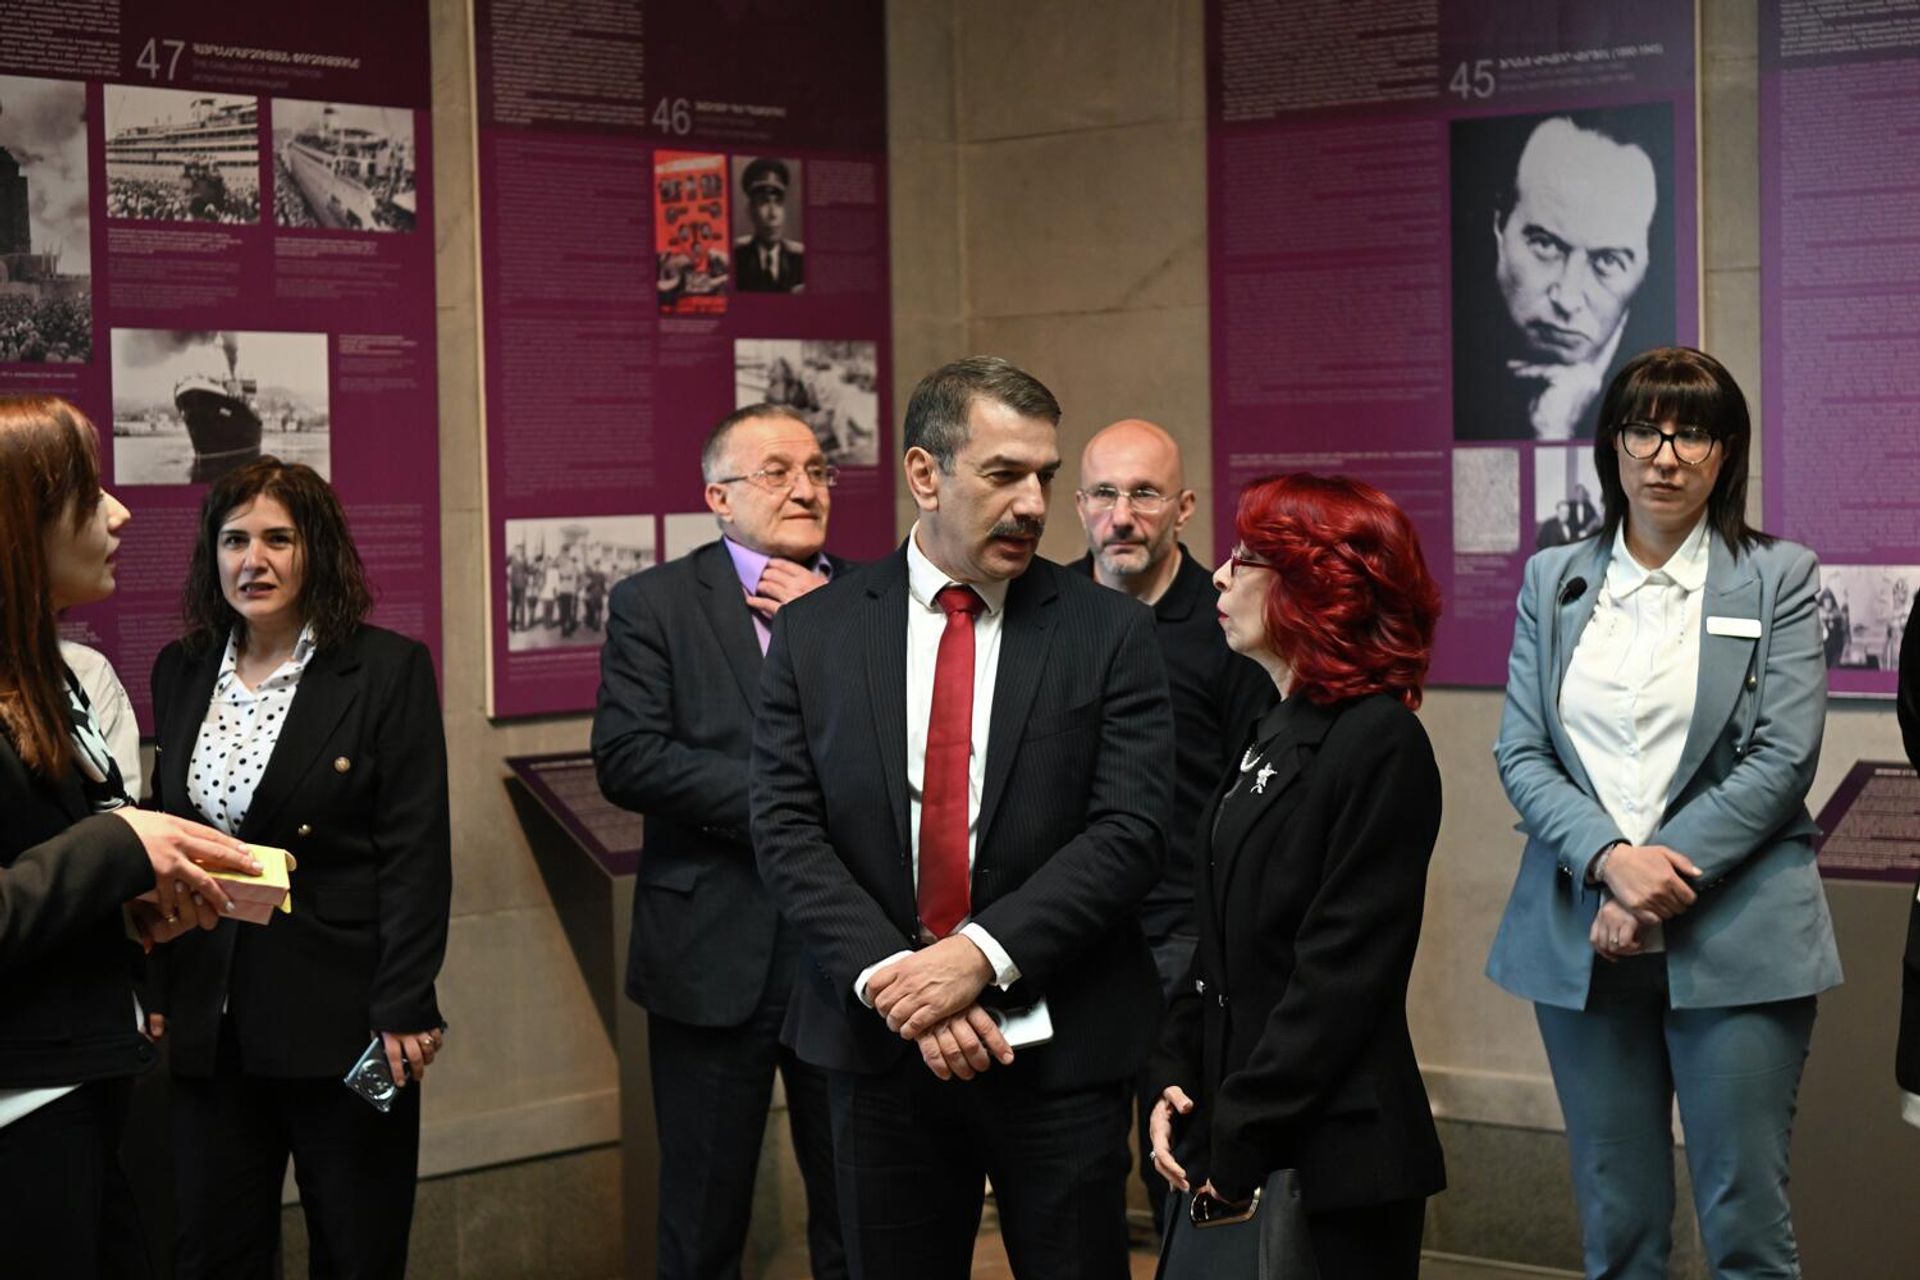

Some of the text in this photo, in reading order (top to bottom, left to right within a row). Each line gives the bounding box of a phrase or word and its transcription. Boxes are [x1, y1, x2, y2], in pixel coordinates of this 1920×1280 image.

[136, 37, 185, 81] 47
[1450, 60, 1495, 99] 45
[652, 97, 691, 135] 46
